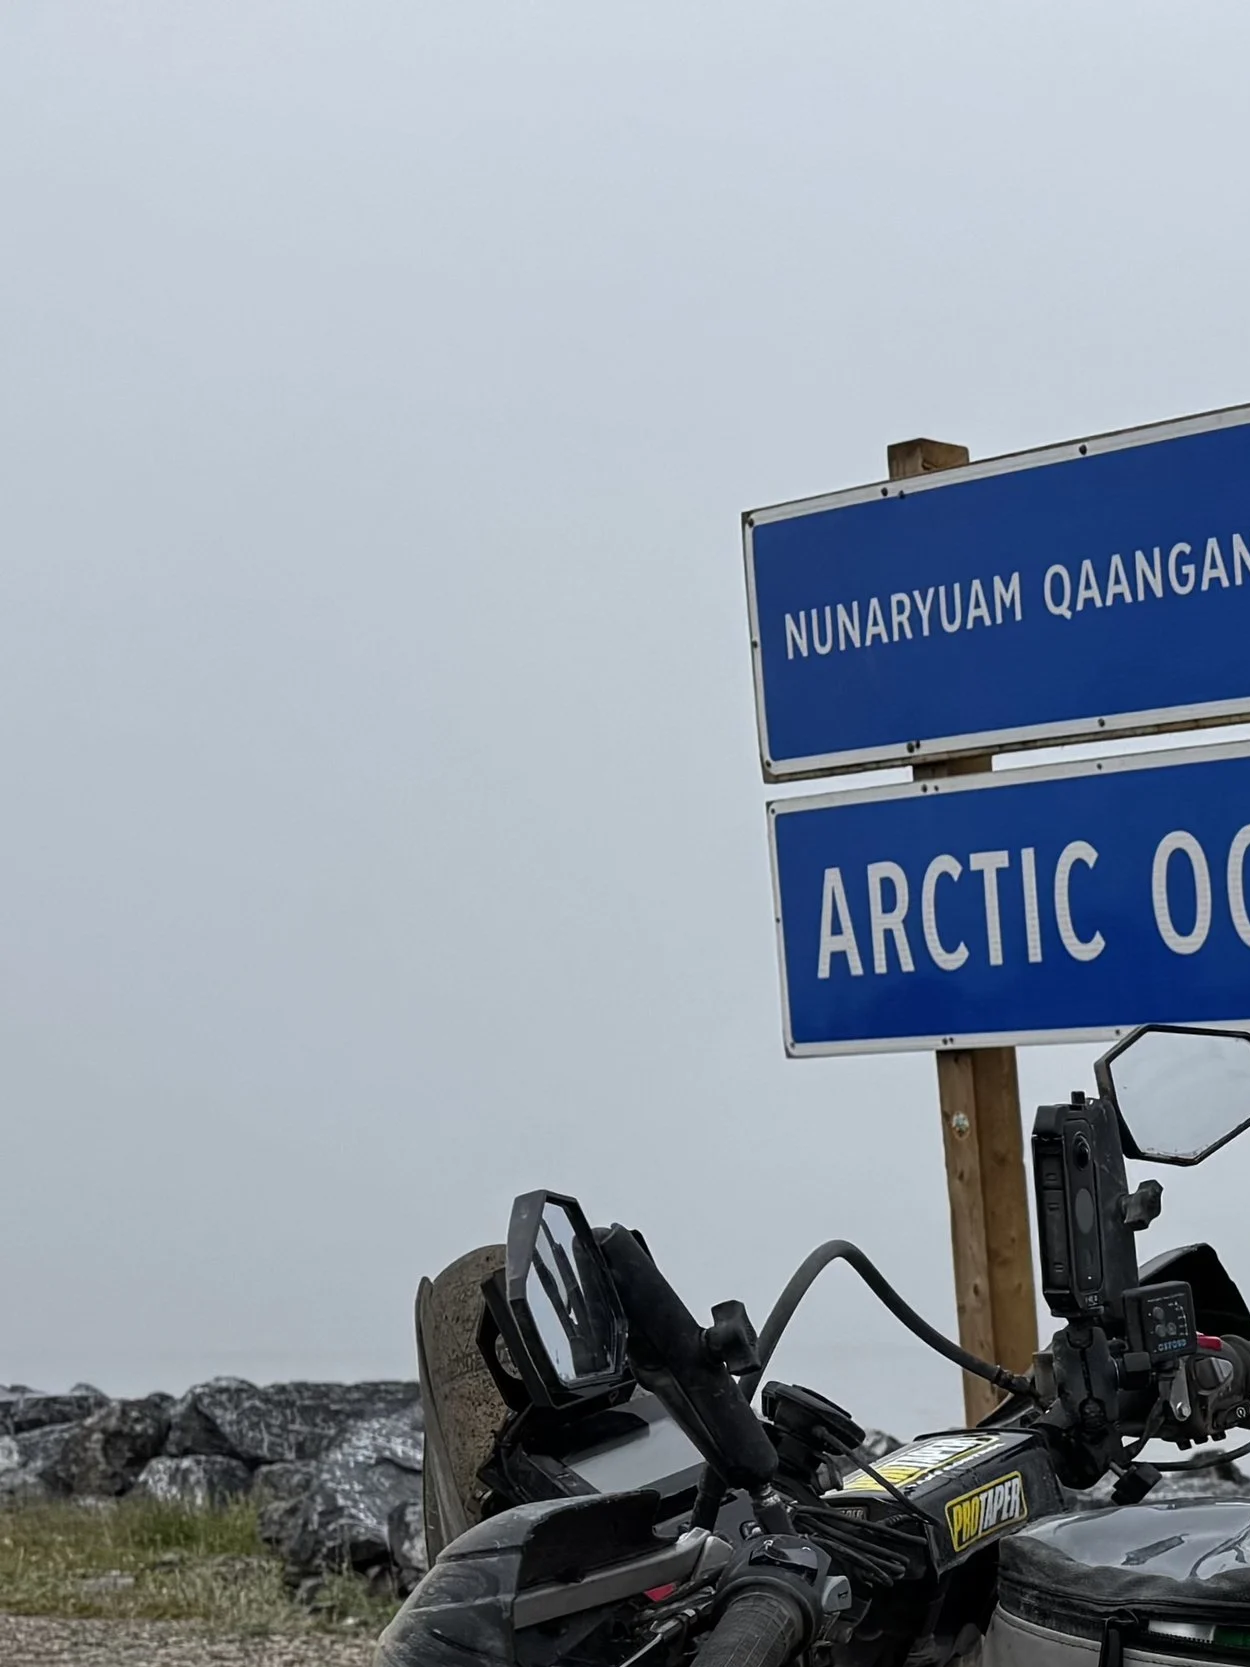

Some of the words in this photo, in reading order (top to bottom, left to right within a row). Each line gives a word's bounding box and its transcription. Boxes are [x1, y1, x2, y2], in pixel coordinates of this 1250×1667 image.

[786, 572, 1022, 659] NUNARYUAM
[817, 841, 1106, 978] ARCTIC
[952, 1476, 1022, 1543] PROTAPER
